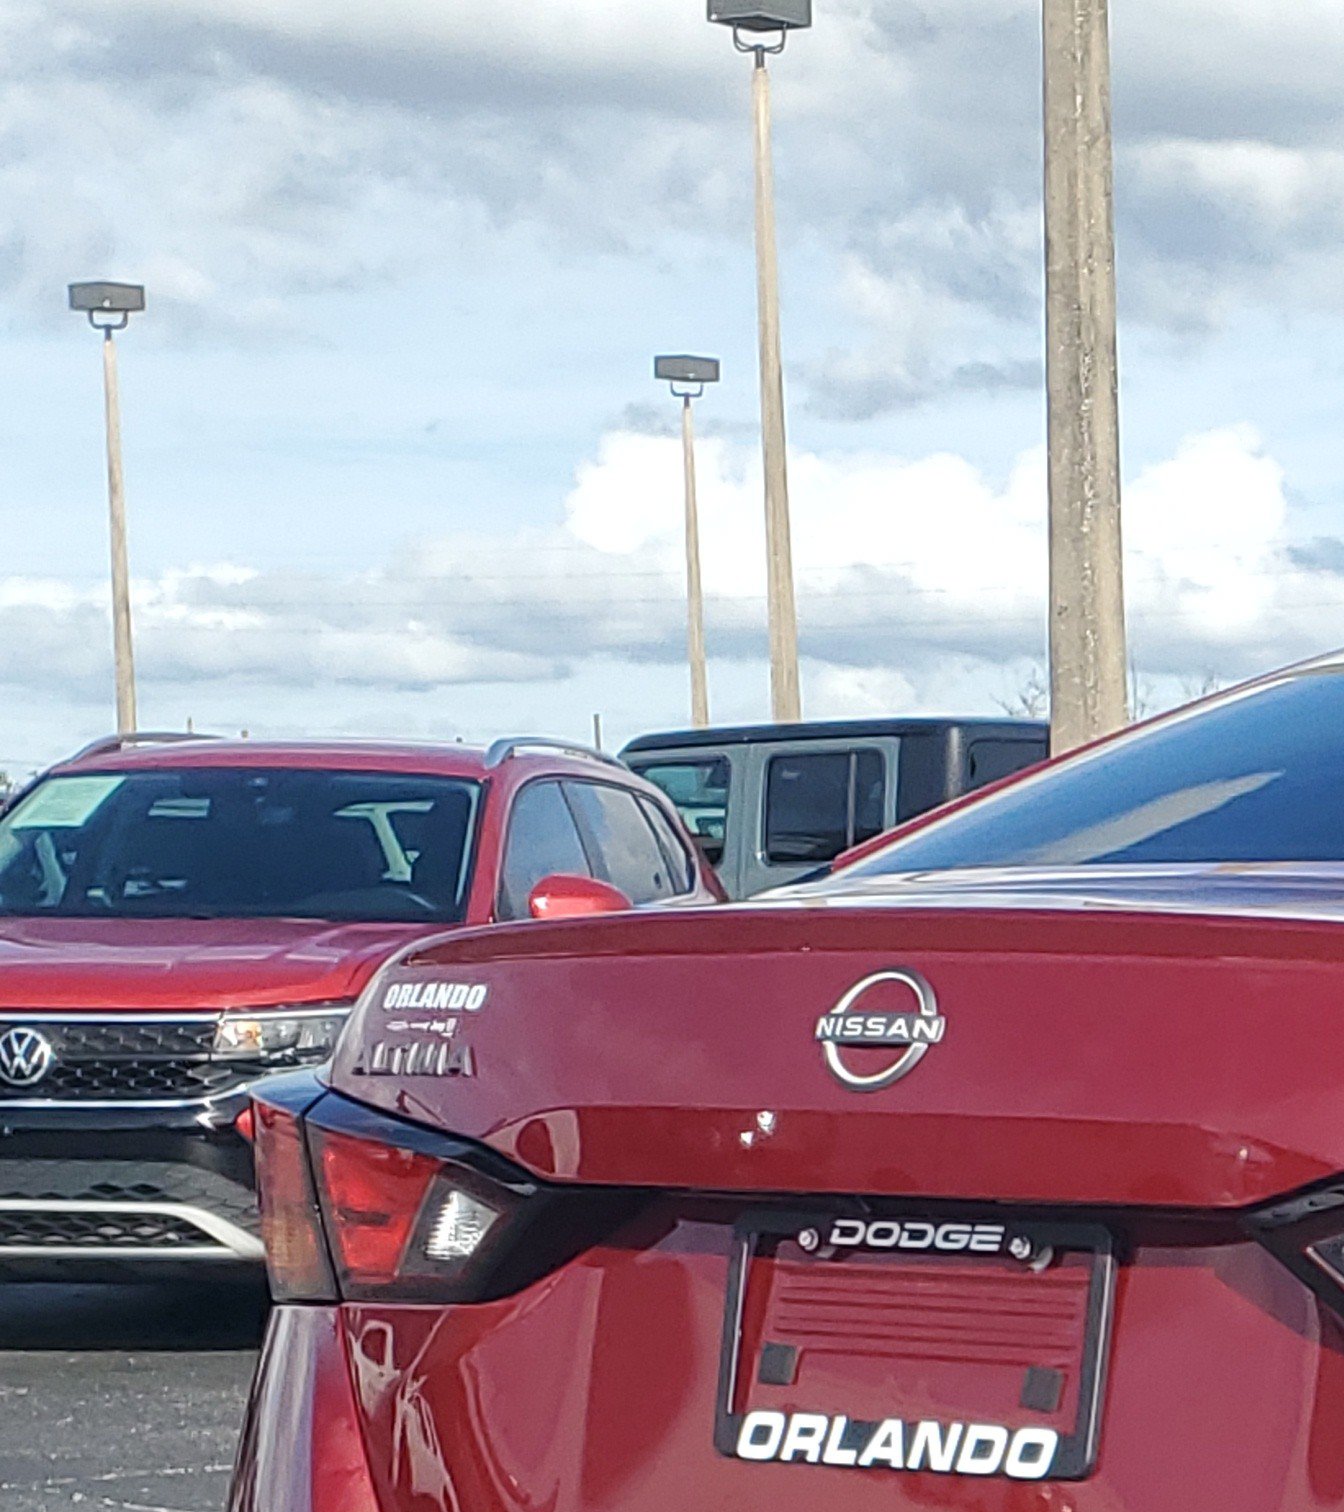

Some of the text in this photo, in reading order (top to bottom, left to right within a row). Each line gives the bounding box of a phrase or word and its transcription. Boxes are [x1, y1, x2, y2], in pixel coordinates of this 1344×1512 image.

[382, 983, 488, 1009] ORLANDO
[815, 1016, 940, 1039] NISSAN
[830, 1219, 1005, 1252] DODGE
[736, 1410, 1059, 1479] ORLANDO
